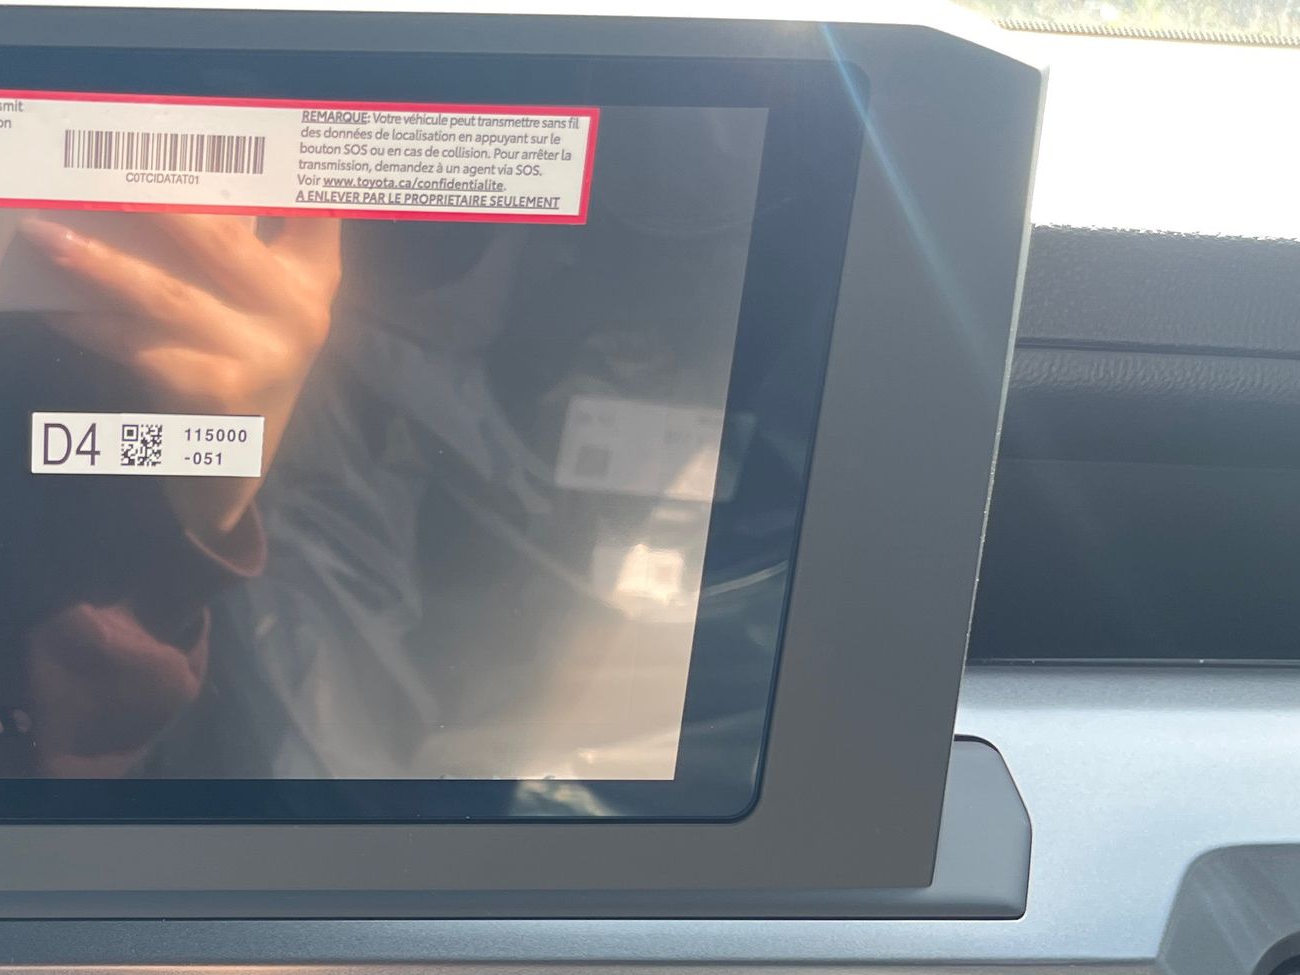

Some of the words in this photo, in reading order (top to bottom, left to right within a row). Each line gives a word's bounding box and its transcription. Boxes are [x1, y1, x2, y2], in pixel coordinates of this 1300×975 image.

[301, 110, 371, 124] REMARQUE:
[373, 112, 400, 124] Votre
[403, 112, 448, 126] véhicule
[450, 115, 475, 128] peut
[478, 116, 540, 128] transmettre
[541, 119, 566, 129] sans
[568, 117, 579, 129] fil
[301, 126, 321, 138] des
[323, 127, 372, 139] données
[375, 128, 390, 140] de
[392, 129, 456, 142] localisation
[458, 133, 473, 142] en
[475, 134, 529, 146] appuyant
[530, 135, 548, 144] sur
[550, 133, 561, 145] le
[300, 142, 341, 154] bouton
[343, 144, 368, 155] SOS
[370, 146, 384, 156] ou
[387, 147, 401, 156] en
[403, 147, 422, 157] cas
[424, 146, 439, 157] de
[442, 146, 490, 159] collision.
[493, 148, 519, 160] Pour
[521, 149, 559, 160] arrêter
[561, 149, 572, 160] la
[299, 160, 372, 173] transmission,
[374, 161, 434, 173] demandez
[436, 162, 443, 174] à
[445, 165, 460, 174] un
[462, 164, 496, 177] agent
[497, 164, 513, 175] via
[515, 164, 542, 176] SOS.
[297, 173, 321, 186] Voir
[322, 176, 507, 192] www.toyota.ca/confidentialite.
[295, 190, 305, 202] A
[307, 191, 360, 203] ENLEVER
[363, 192, 385, 204] PAR
[389, 193, 401, 205] LE
[404, 193, 487, 207] PROPRIETAIRE
[490, 195, 560, 209] SEULEMENT
[43, 422, 100, 466] D4
[184, 428, 248, 443] 115000
[184, 452, 223, 465] -051
